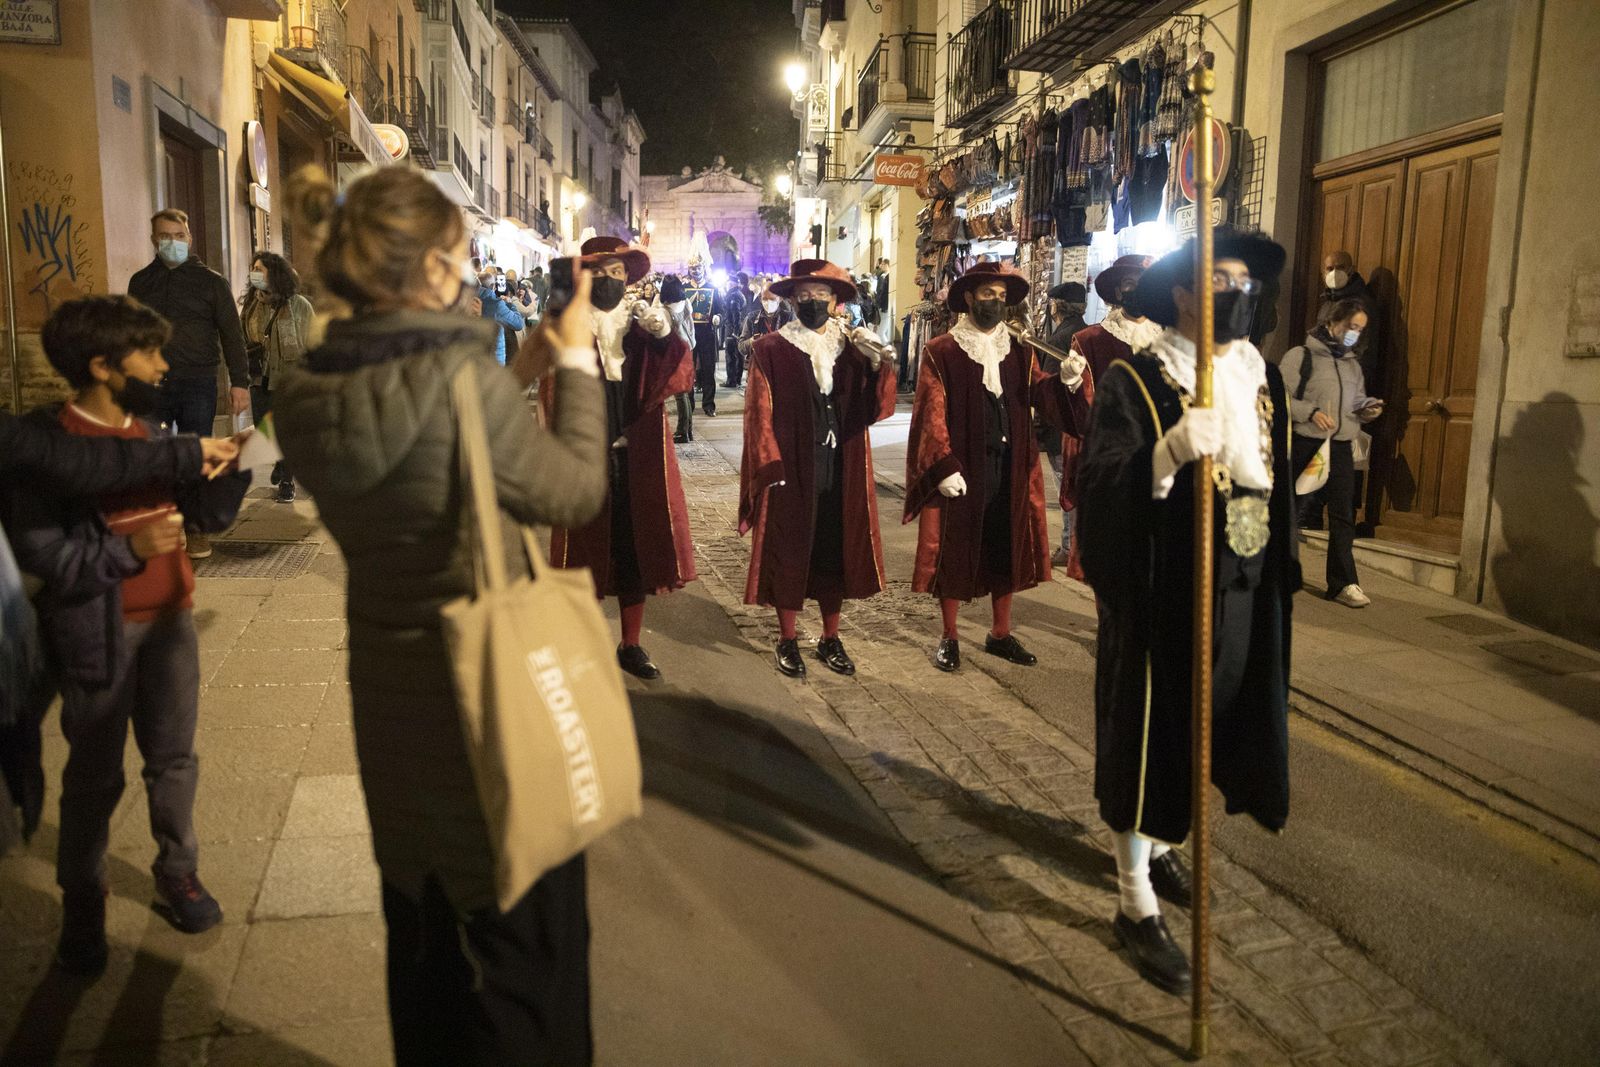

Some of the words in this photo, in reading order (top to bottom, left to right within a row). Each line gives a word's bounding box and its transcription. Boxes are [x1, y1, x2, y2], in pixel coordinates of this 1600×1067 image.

[1, 21, 33, 32] BAJA
[1181, 210, 1192, 219] EN
[536, 665, 601, 824] ROASTERY
